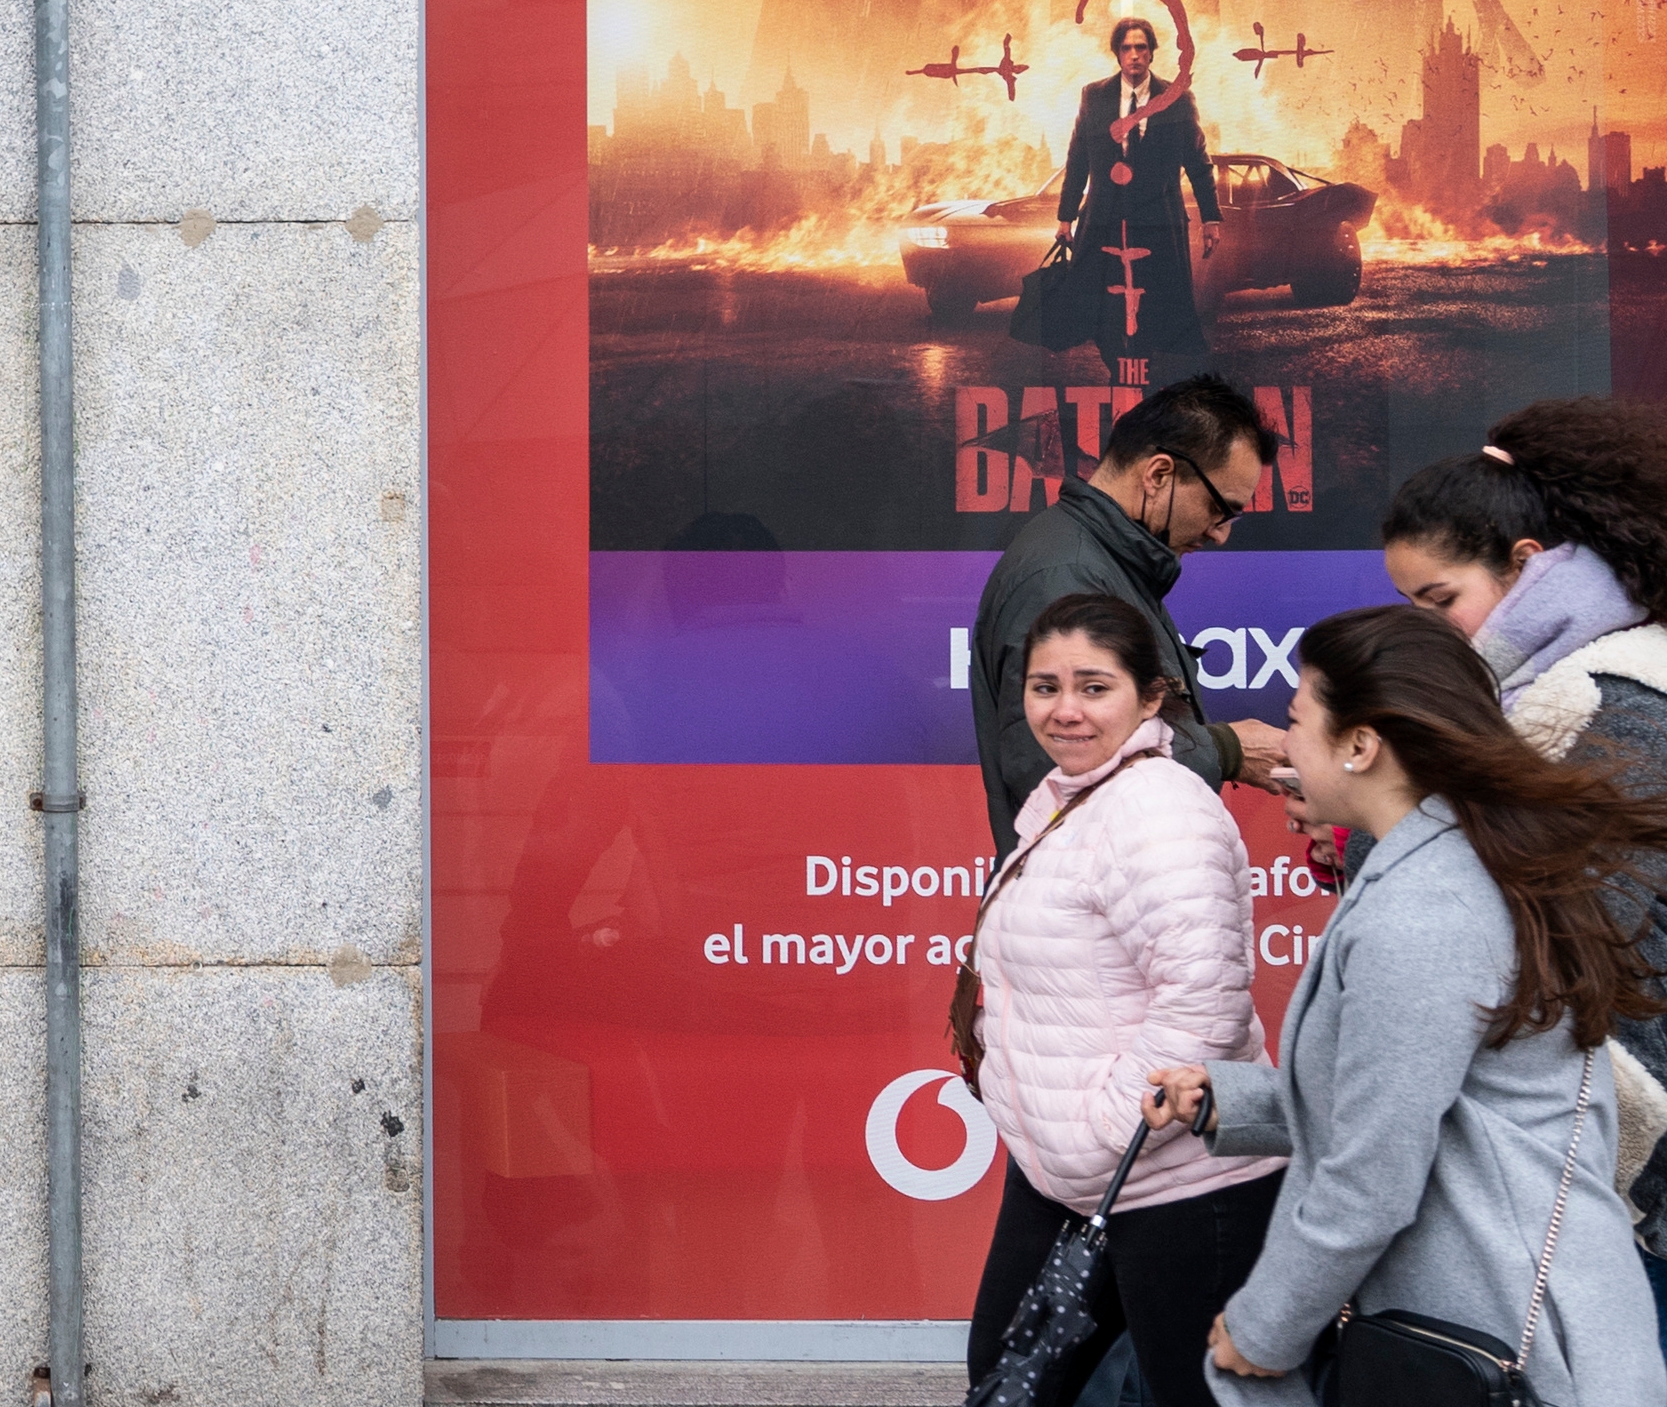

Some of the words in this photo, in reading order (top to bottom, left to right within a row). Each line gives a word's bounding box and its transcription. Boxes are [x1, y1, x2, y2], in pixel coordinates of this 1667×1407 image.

[1118, 357, 1150, 385] THE
[955, 386, 1313, 513] BATN
[1289, 490, 1310, 505] DC
[805, 855, 995, 906] Disponi
[703, 924, 746, 965] el
[763, 932, 915, 976] mayor
